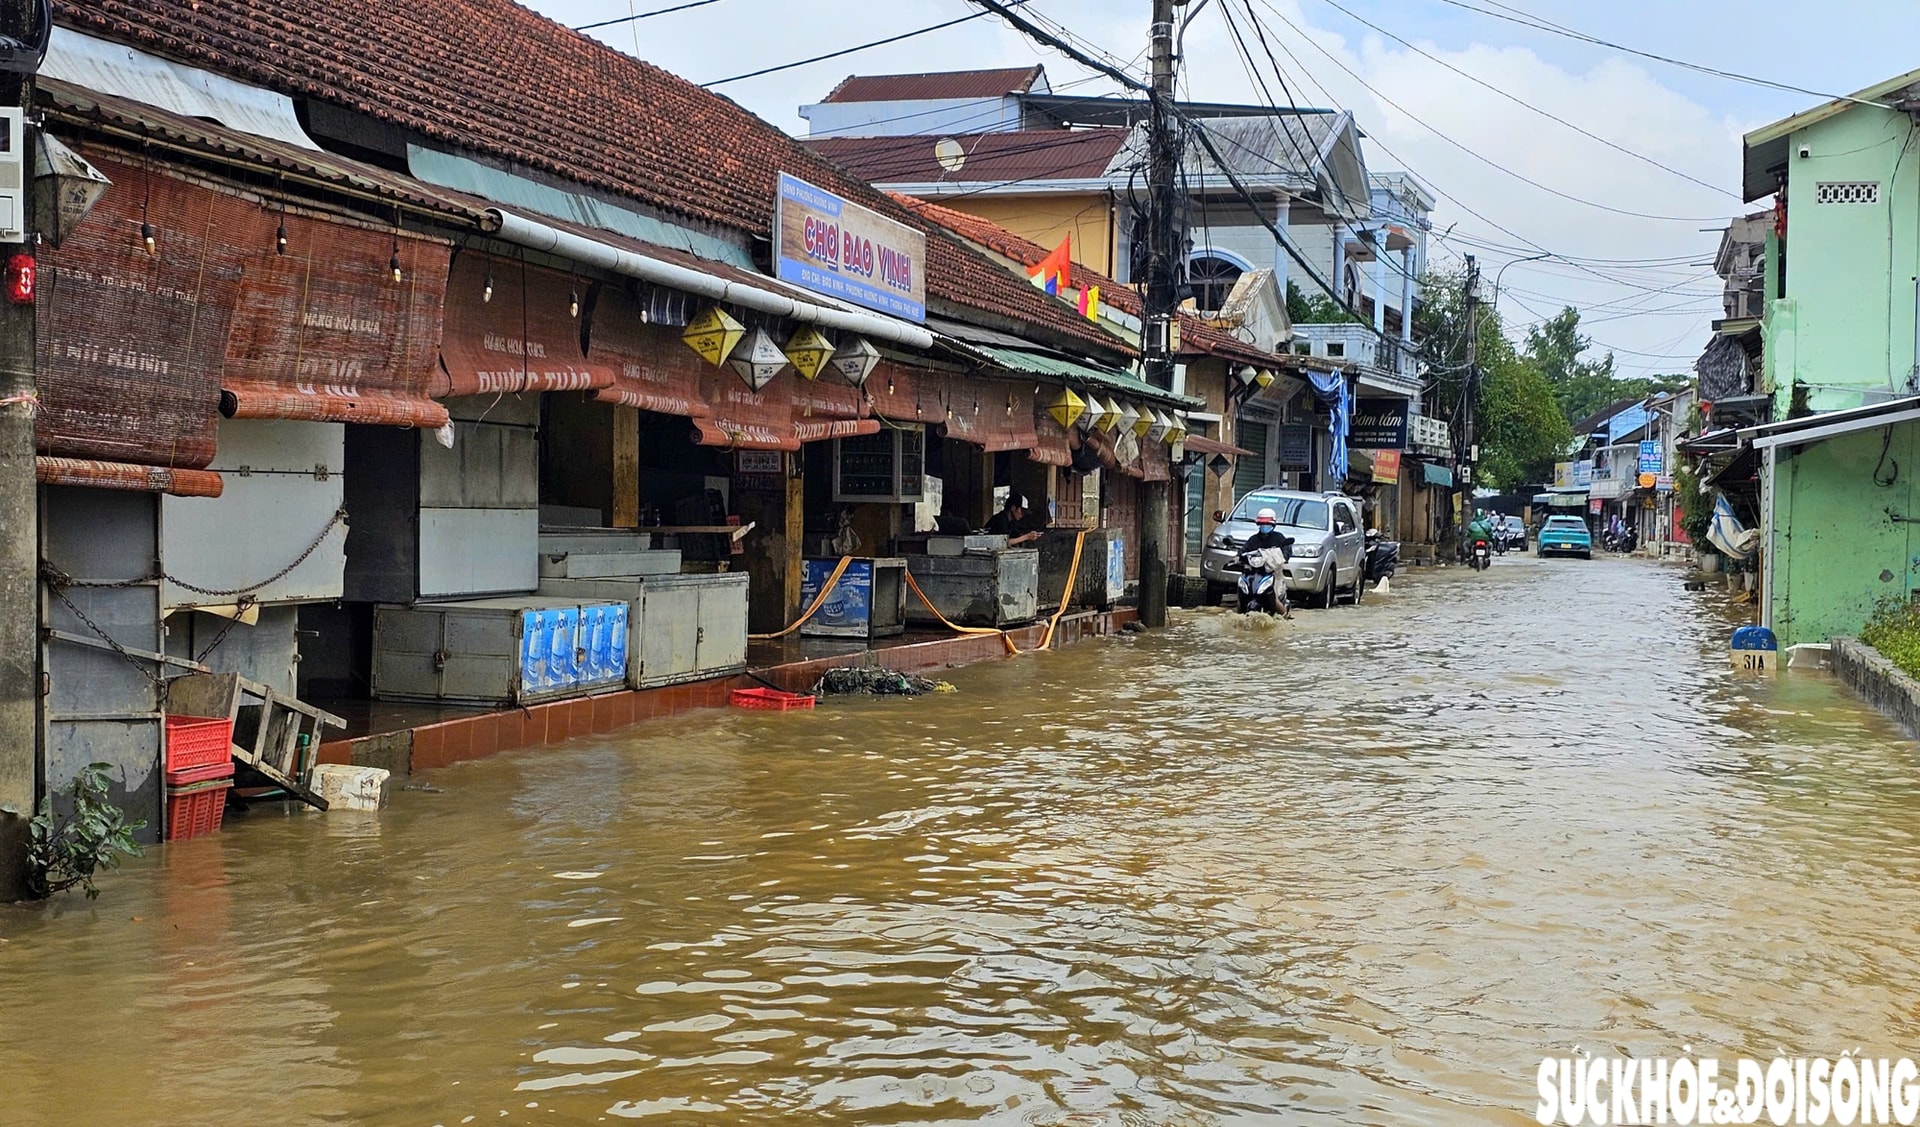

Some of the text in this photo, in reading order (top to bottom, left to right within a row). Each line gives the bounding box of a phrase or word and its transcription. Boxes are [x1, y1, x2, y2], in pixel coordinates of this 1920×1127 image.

[803, 214, 913, 293] CHỢ BAO VINH
[1378, 409, 1404, 427] tấm
